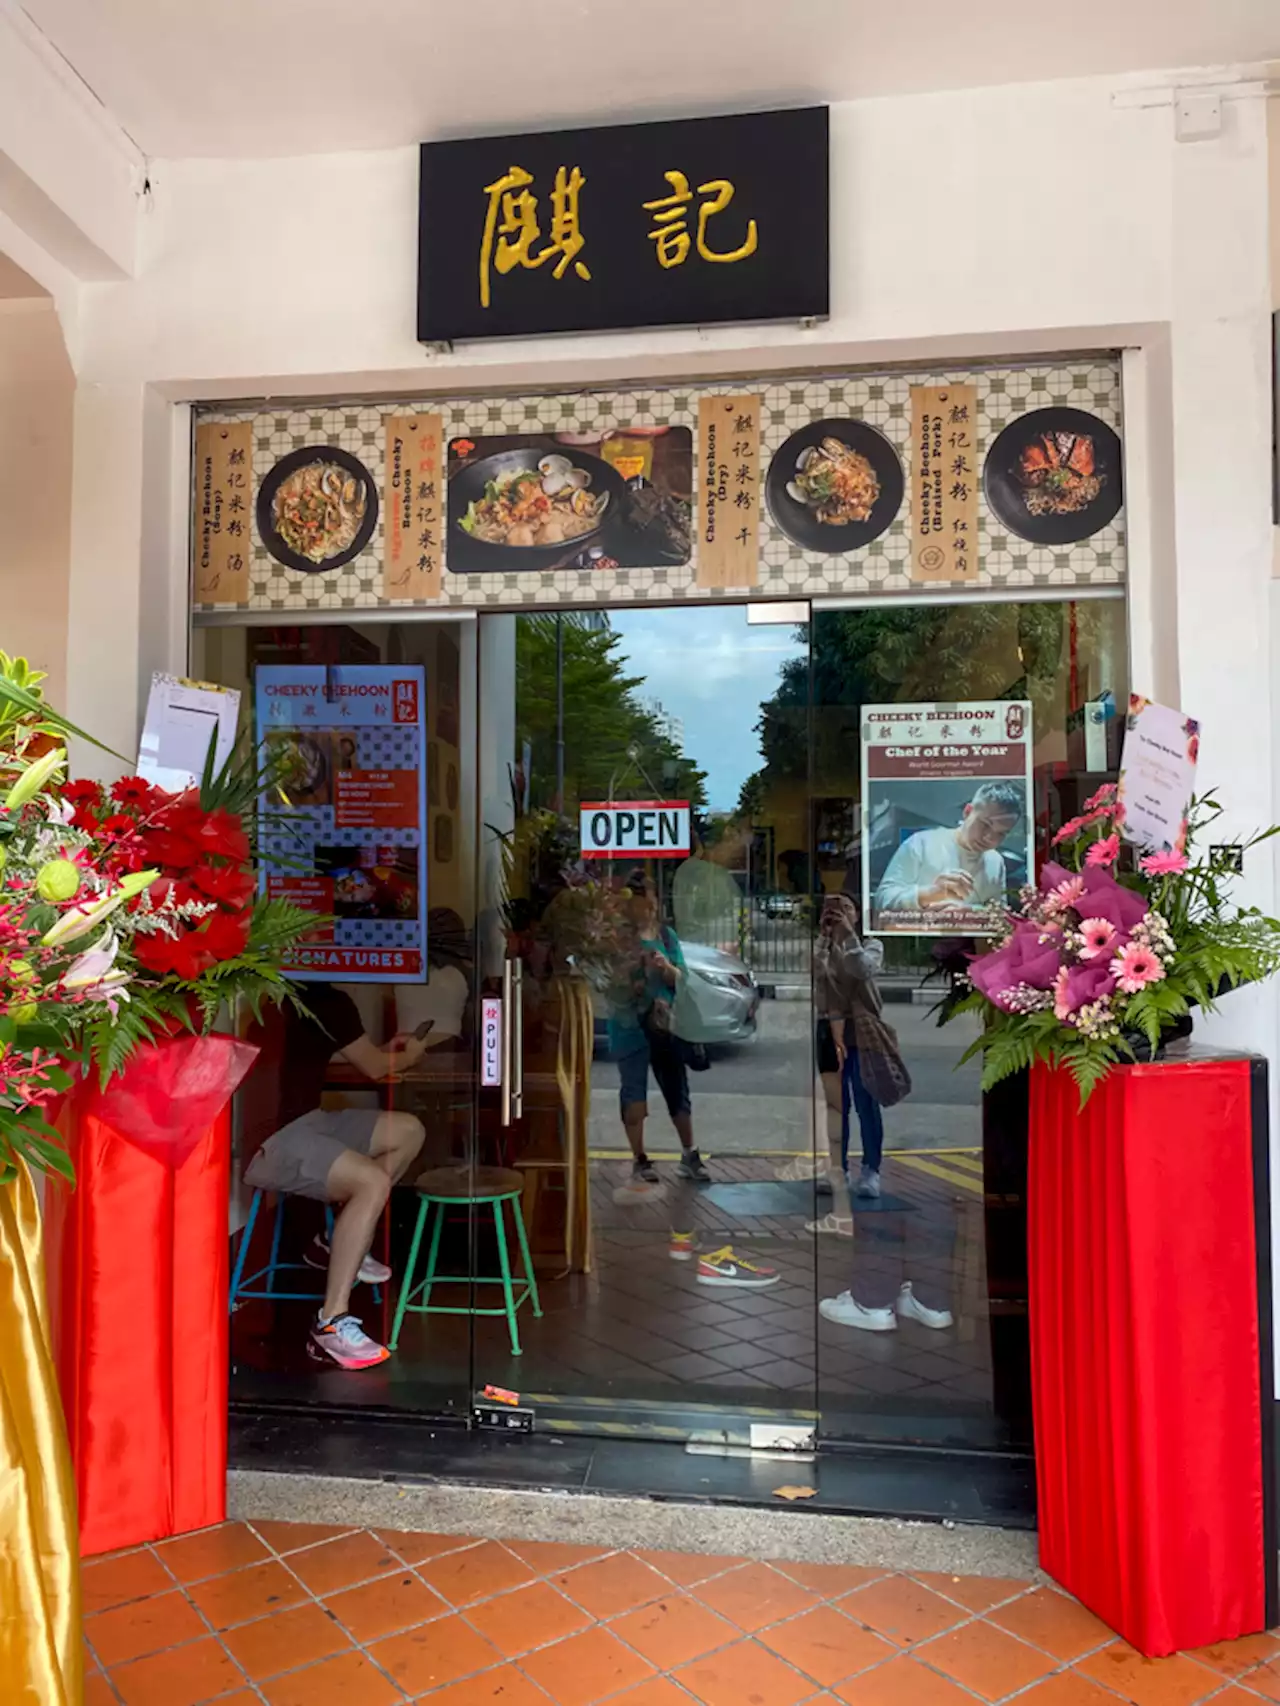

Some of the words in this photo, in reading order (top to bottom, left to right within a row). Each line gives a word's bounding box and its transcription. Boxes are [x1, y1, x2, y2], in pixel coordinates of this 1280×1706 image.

[392, 437, 403, 488] Cheeky
[706, 424, 716, 486] Beehoon
[920, 414, 930, 477] Beehoon
[932, 416, 943, 458] Pork)
[203, 457, 213, 515] Beehoon
[402, 469, 412, 529] Beehoon
[718, 464, 729, 501] (Dry)
[932, 470, 943, 532] (Braised
[213, 489, 224, 534] (Soup)
[706, 490, 718, 543] Cheeky
[920, 482, 932, 535] Cheeky
[201, 518, 215, 569] Cheeky
[735, 527, 751, 546] 干
[265, 685, 319, 697] CHEEKY
[868, 712, 923, 723] CHEEKY
[926, 710, 995, 721] BEEHOON
[885, 747, 920, 758] Chef
[923, 746, 940, 757] of
[942, 746, 969, 757] the
[971, 745, 1008, 756] Year
[591, 812, 679, 846] OPEN
[487, 1023, 496, 1077] PULL
